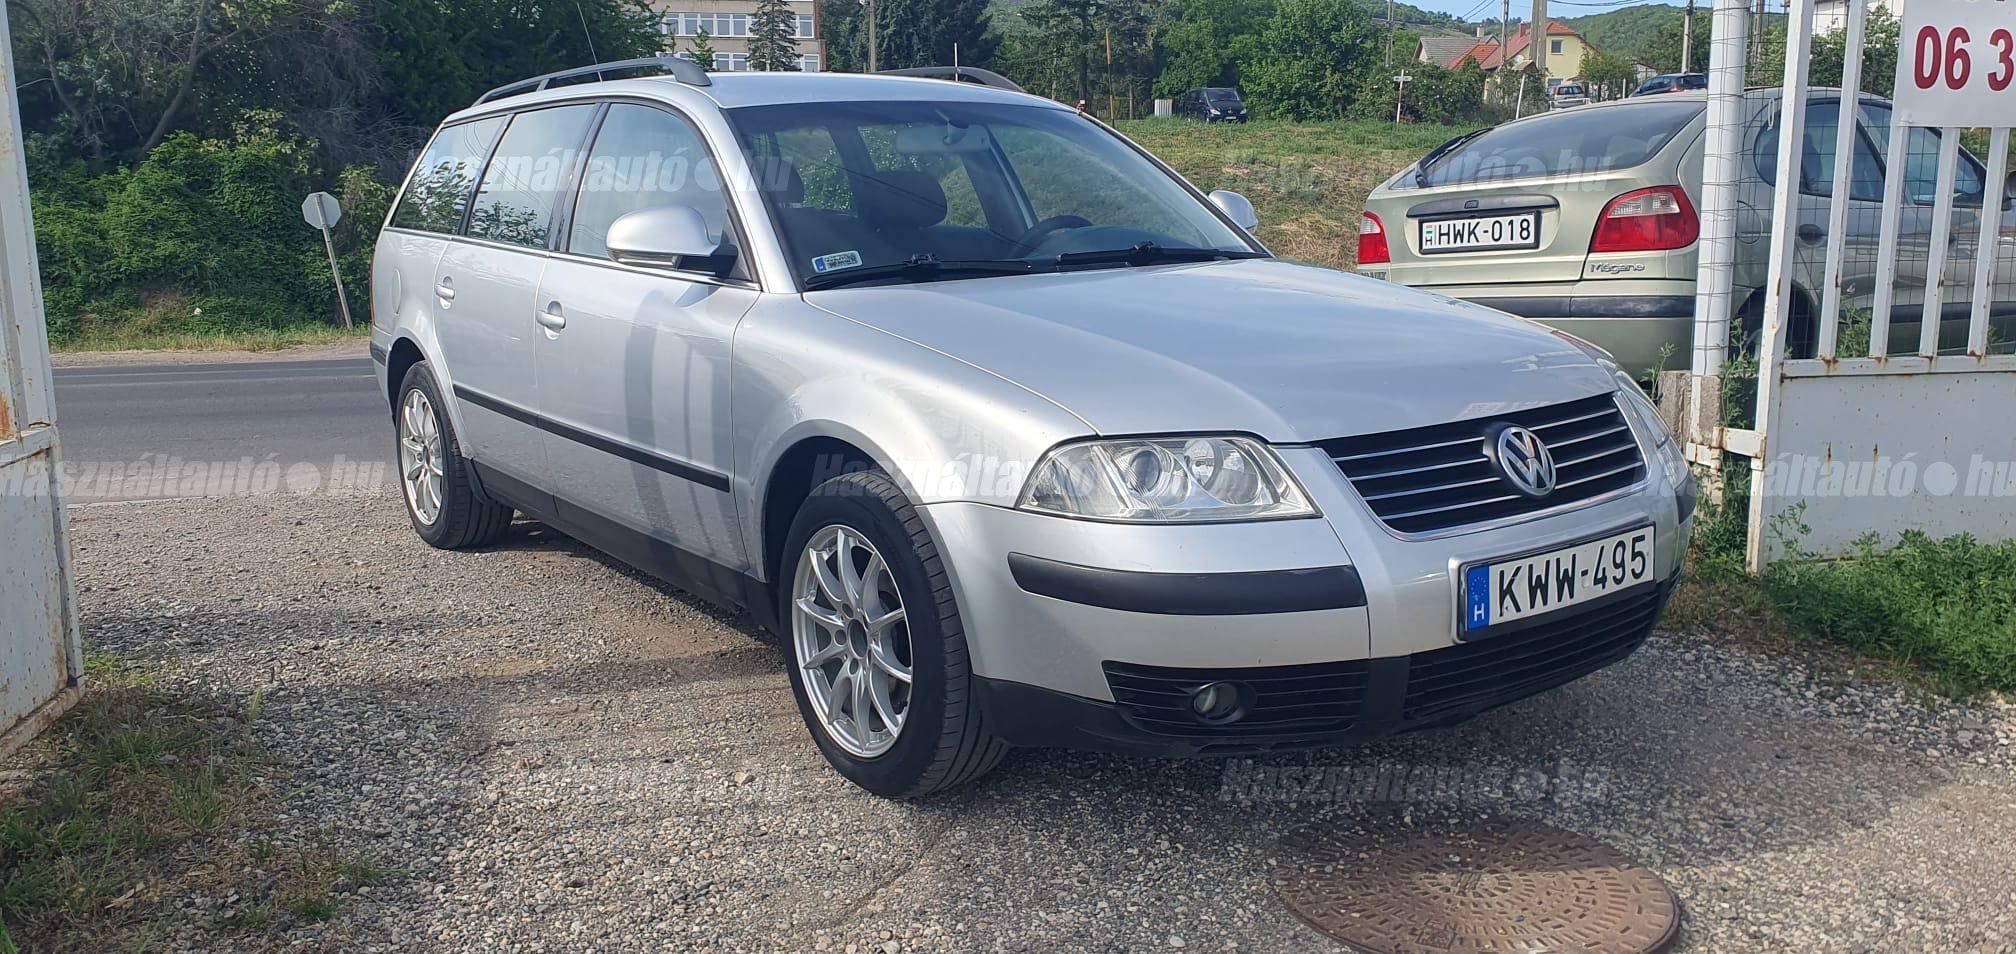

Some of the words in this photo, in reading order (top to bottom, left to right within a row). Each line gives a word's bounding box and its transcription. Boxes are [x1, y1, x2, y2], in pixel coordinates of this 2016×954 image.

[1914, 25, 1970, 90] 06
[1987, 28, 2015, 92] 3
[1438, 218, 1531, 246] HWK-018
[1499, 534, 1646, 617] KWW-495
